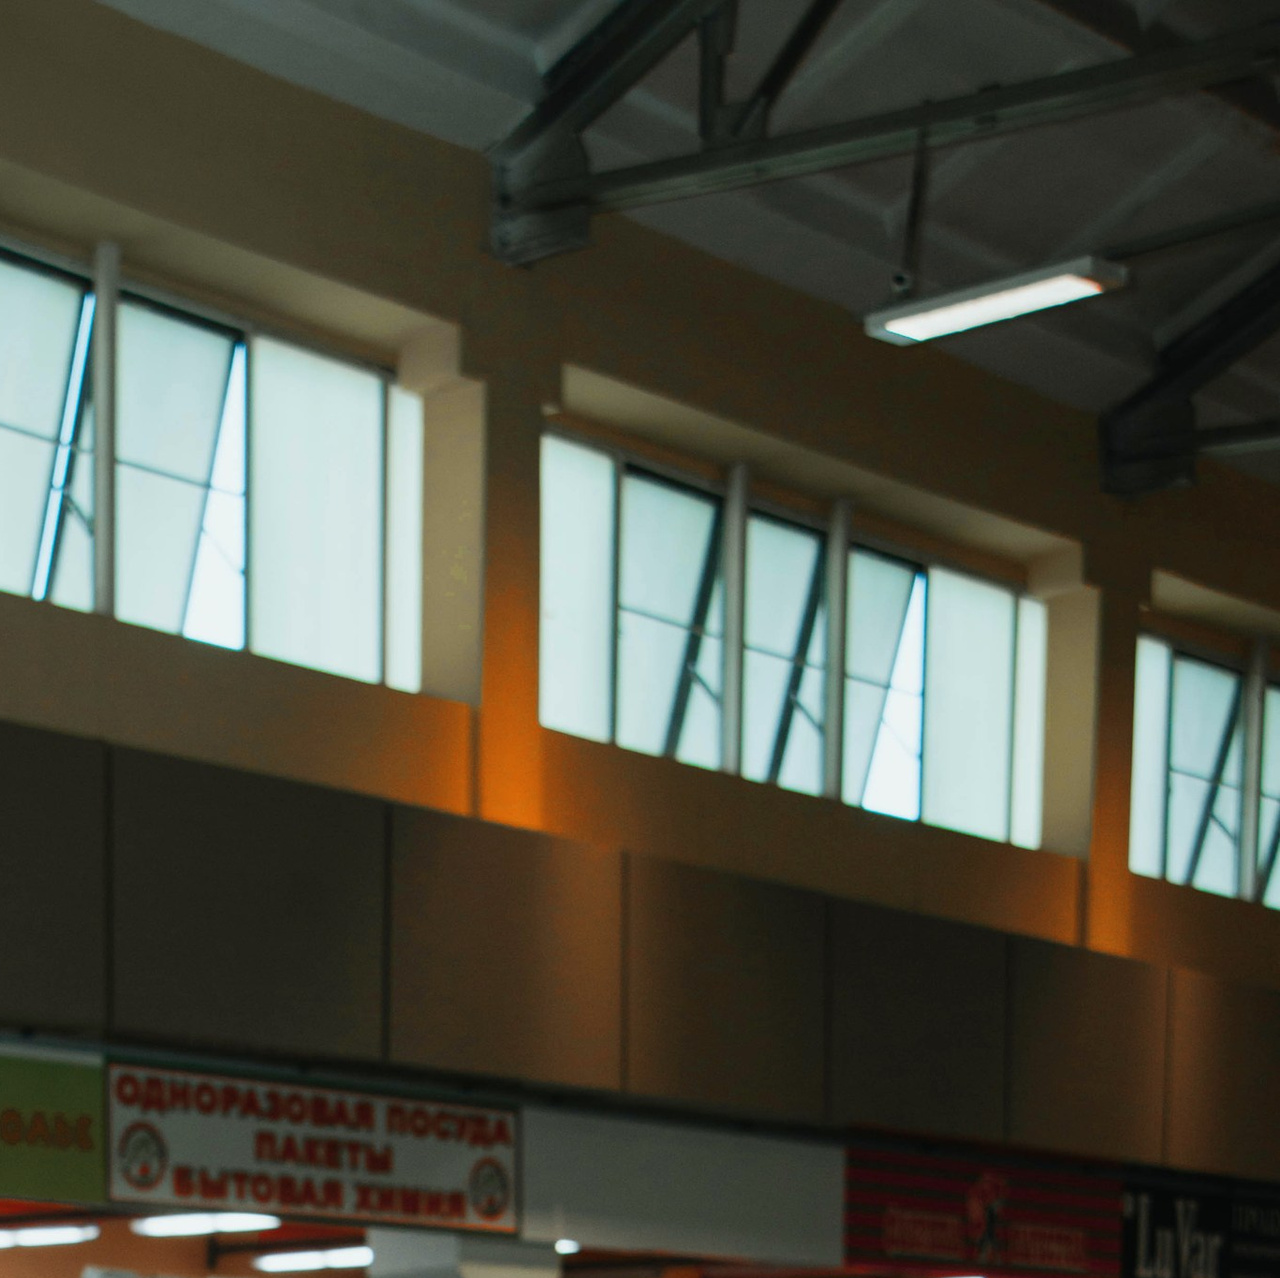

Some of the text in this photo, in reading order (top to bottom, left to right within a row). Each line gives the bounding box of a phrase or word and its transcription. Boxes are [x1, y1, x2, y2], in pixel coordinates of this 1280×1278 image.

[114, 1074, 513, 1148] ОДНОРАЗОВАЯ ПОСУДА
[254, 1130, 395, 1174] ПАКЕТЫ
[172, 1166, 346, 1209] БЫТОВАЯ
